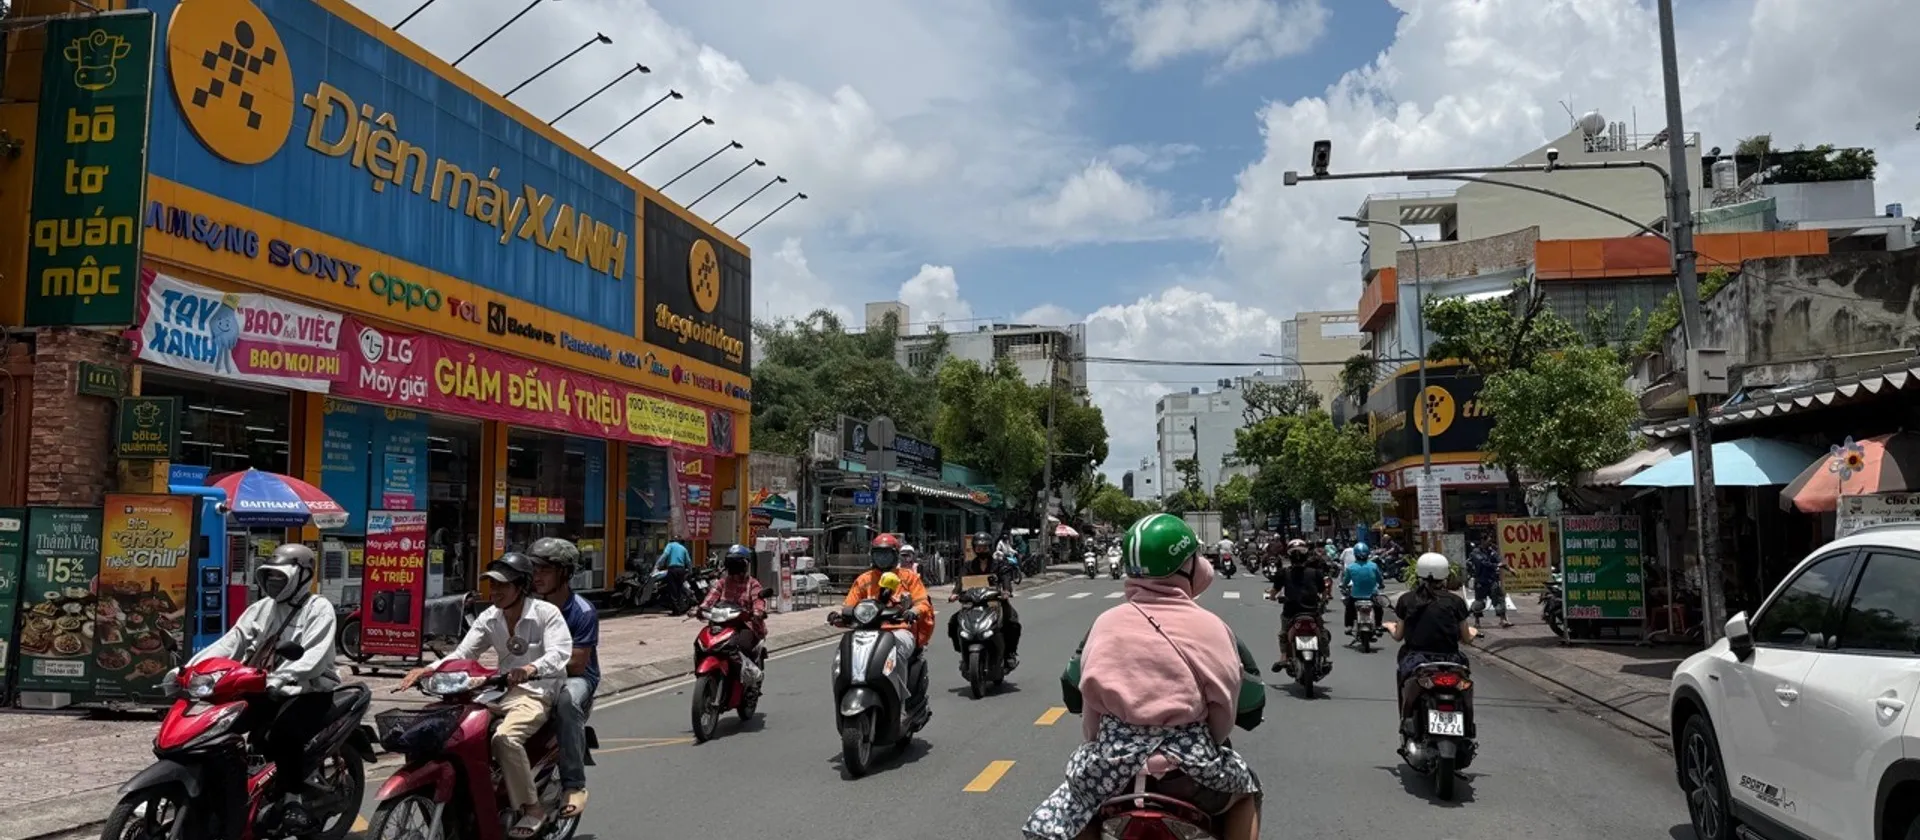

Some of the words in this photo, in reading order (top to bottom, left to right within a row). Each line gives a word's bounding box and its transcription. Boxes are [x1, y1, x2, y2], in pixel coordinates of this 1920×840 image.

[65, 158, 110, 195] tơ
[303, 81, 428, 194] Điện
[430, 158, 526, 245] máy
[516, 183, 628, 281] XANH
[34, 206, 134, 256] quán
[144, 199, 260, 259] AMSUNG
[447, 297, 482, 325] TCL
[41, 255, 121, 304] mộc
[161, 289, 220, 331] TAY
[149, 322, 218, 364] XANH
[298, 315, 337, 349] VIỆC
[249, 348, 282, 370] BAO
[285, 351, 315, 378] MỌI
[316, 353, 340, 376] PHÍ
[387, 336, 413, 364] LG
[360, 365, 396, 399] Máy
[434, 352, 501, 404] GIẢM
[508, 367, 553, 412] ĐẾN
[557, 378, 572, 416] 4
[575, 389, 622, 434] TRIỆU
[127, 518, 149, 530] Bia
[1503, 521, 1545, 544] CƠM
[36, 533, 71, 549] Thành
[73, 534, 99, 551] Viên
[412, 540, 426, 550] LG
[1168, 535, 1191, 557] Grab
[1566, 536, 1582, 549] BÚN
[1583, 538, 1599, 551] THỊT
[1601, 536, 1617, 549] XÀO
[46, 557, 85, 583] 15%
[366, 552, 398, 568] GIẢM
[400, 552, 424, 568] ĐẾN
[1504, 546, 1548, 570] TẤM
[370, 568, 381, 582] 4
[383, 570, 414, 587] TRIỆU
[1567, 569, 1578, 583] HỦ
[1739, 774, 1766, 792] SPORT
